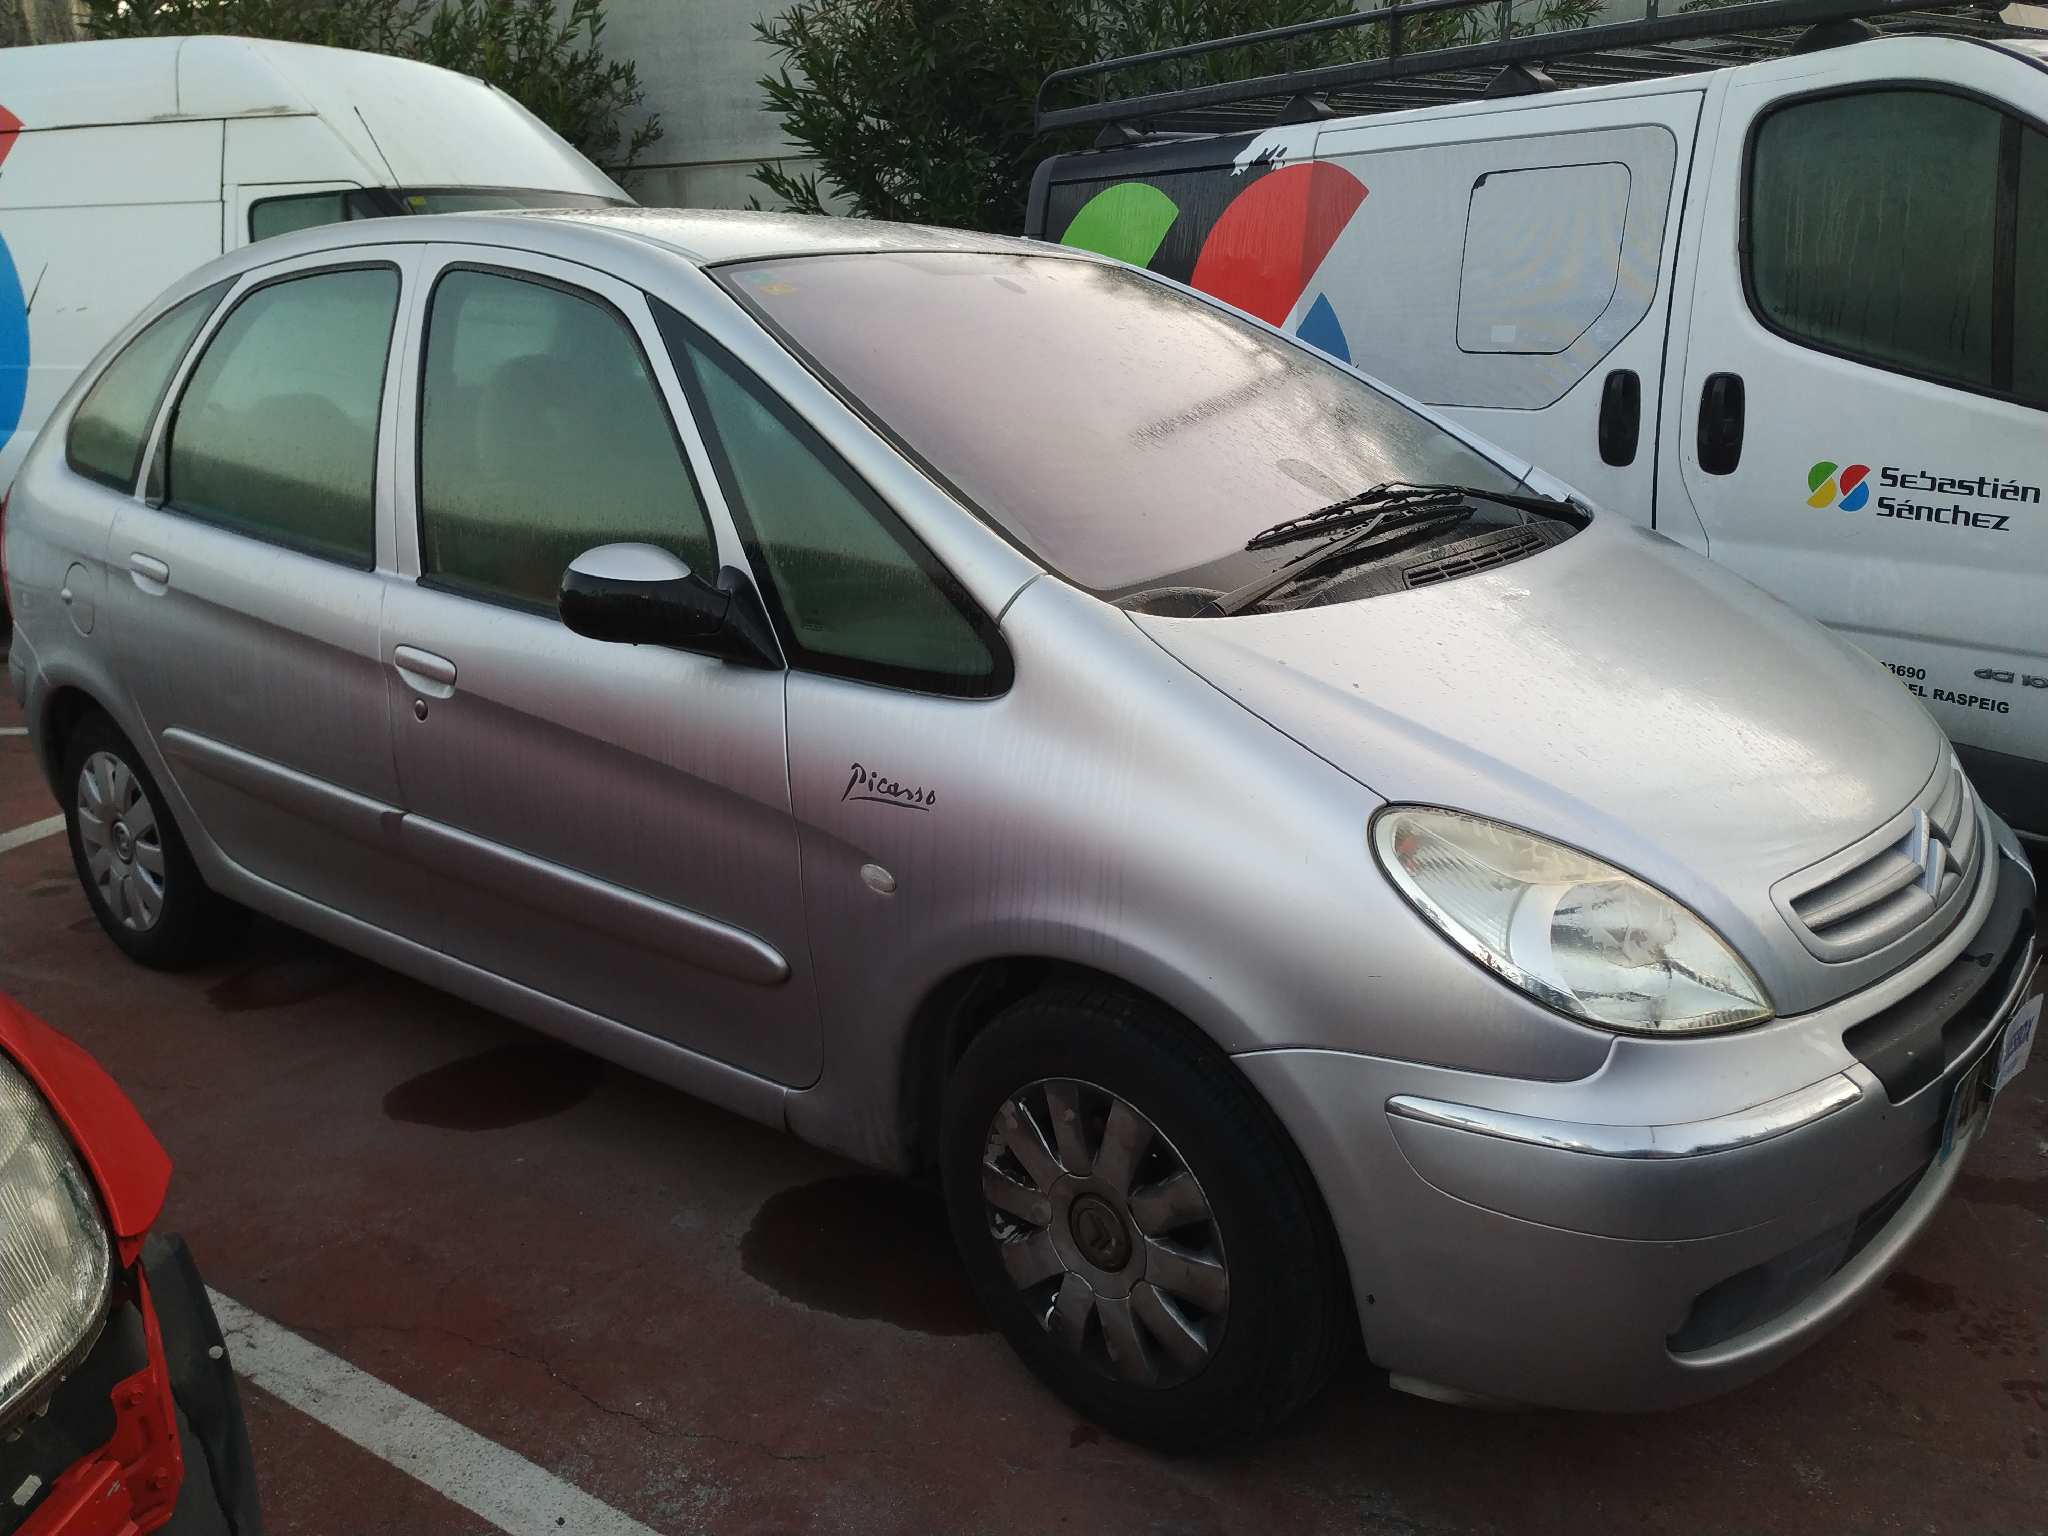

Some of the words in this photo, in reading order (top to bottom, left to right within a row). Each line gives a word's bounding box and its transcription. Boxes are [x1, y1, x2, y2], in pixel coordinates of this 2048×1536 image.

[1880, 466, 2041, 503] Sebastián
[1876, 496, 2010, 531] Sánchez
[1903, 681, 1928, 697] EL
[1933, 688, 2010, 713] RASPEIG
[841, 763, 936, 811] Picasso
